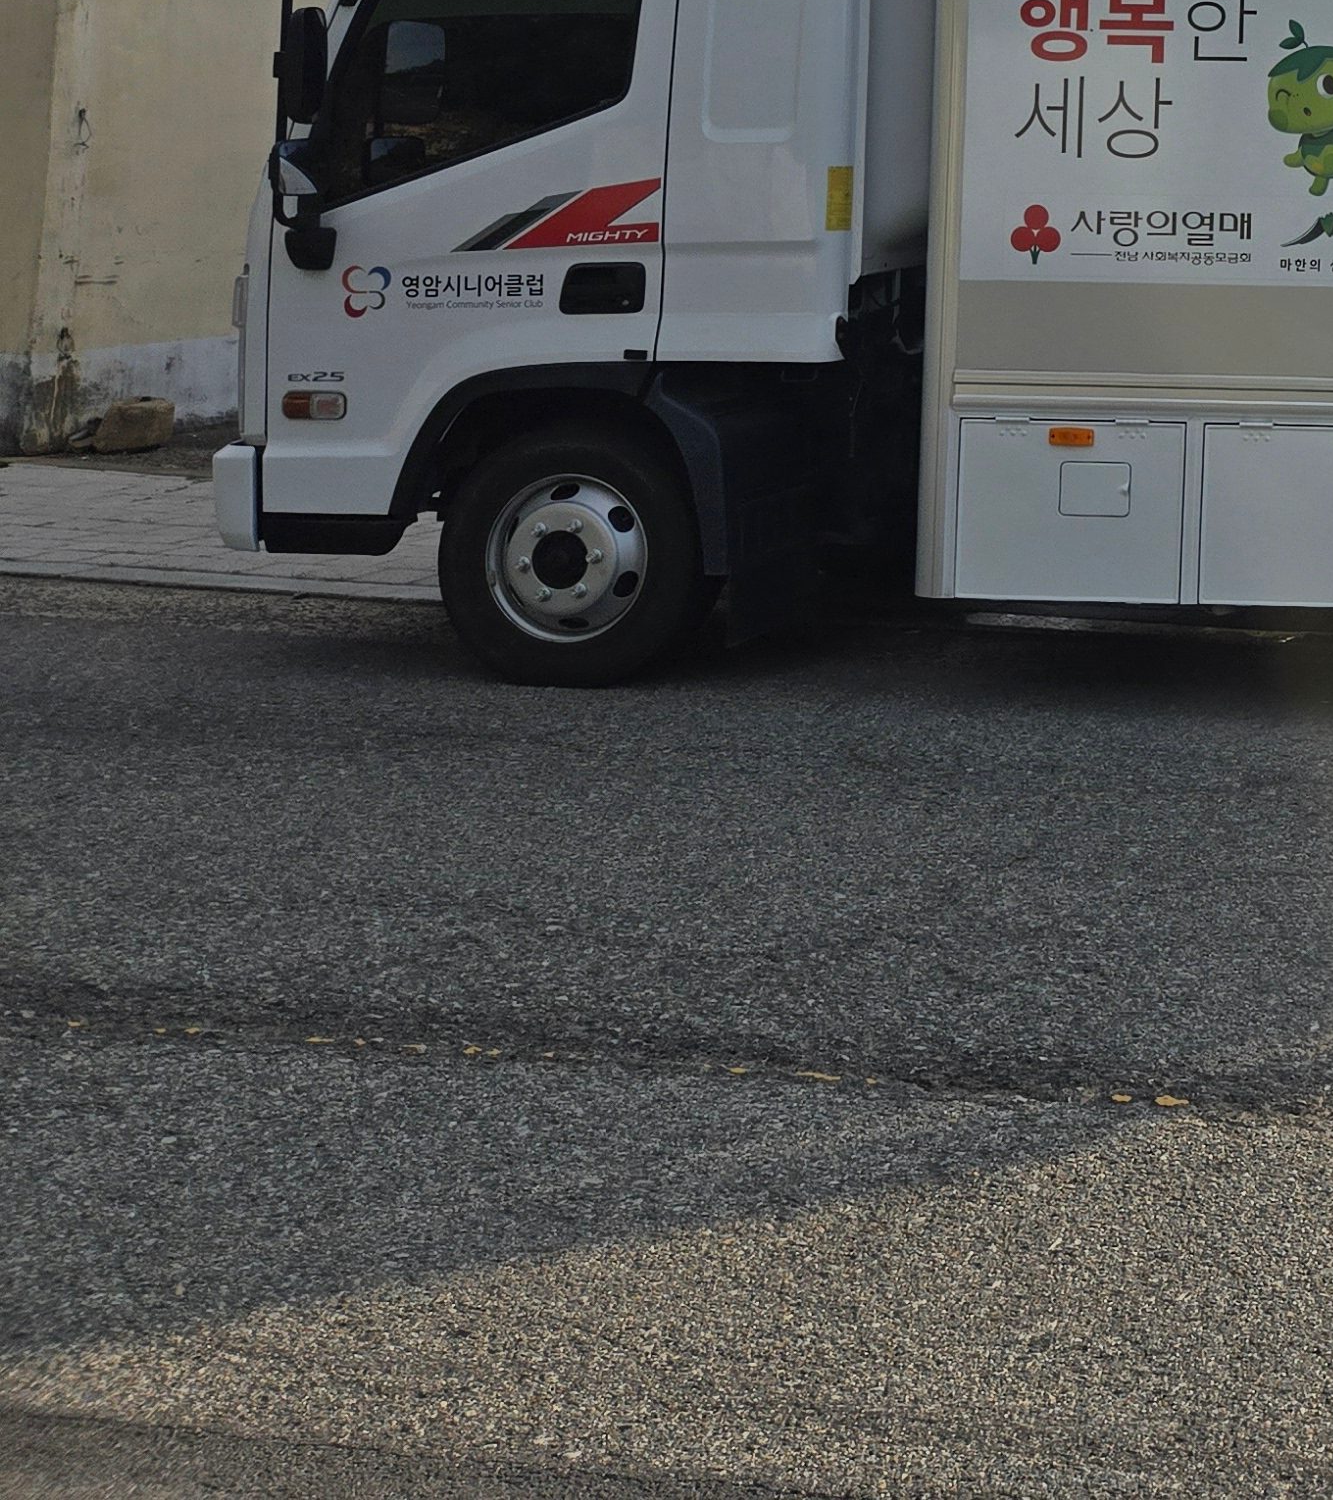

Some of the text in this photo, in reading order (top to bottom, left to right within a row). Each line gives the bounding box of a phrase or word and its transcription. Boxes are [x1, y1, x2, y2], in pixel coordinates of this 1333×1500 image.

[1014, 75, 1173, 159] 세상
[1070, 210, 1252, 247] 사랑의열매
[566, 229, 648, 243] MIGHTY
[1114, 251, 1252, 266] 전남 사회복지공동모금회
[1279, 258, 1321, 272] 마한의
[401, 273, 544, 298] 영암시니어클럽
[405, 300, 544, 311] Yeongam Community Senior Club
[287, 371, 345, 382] EX25
